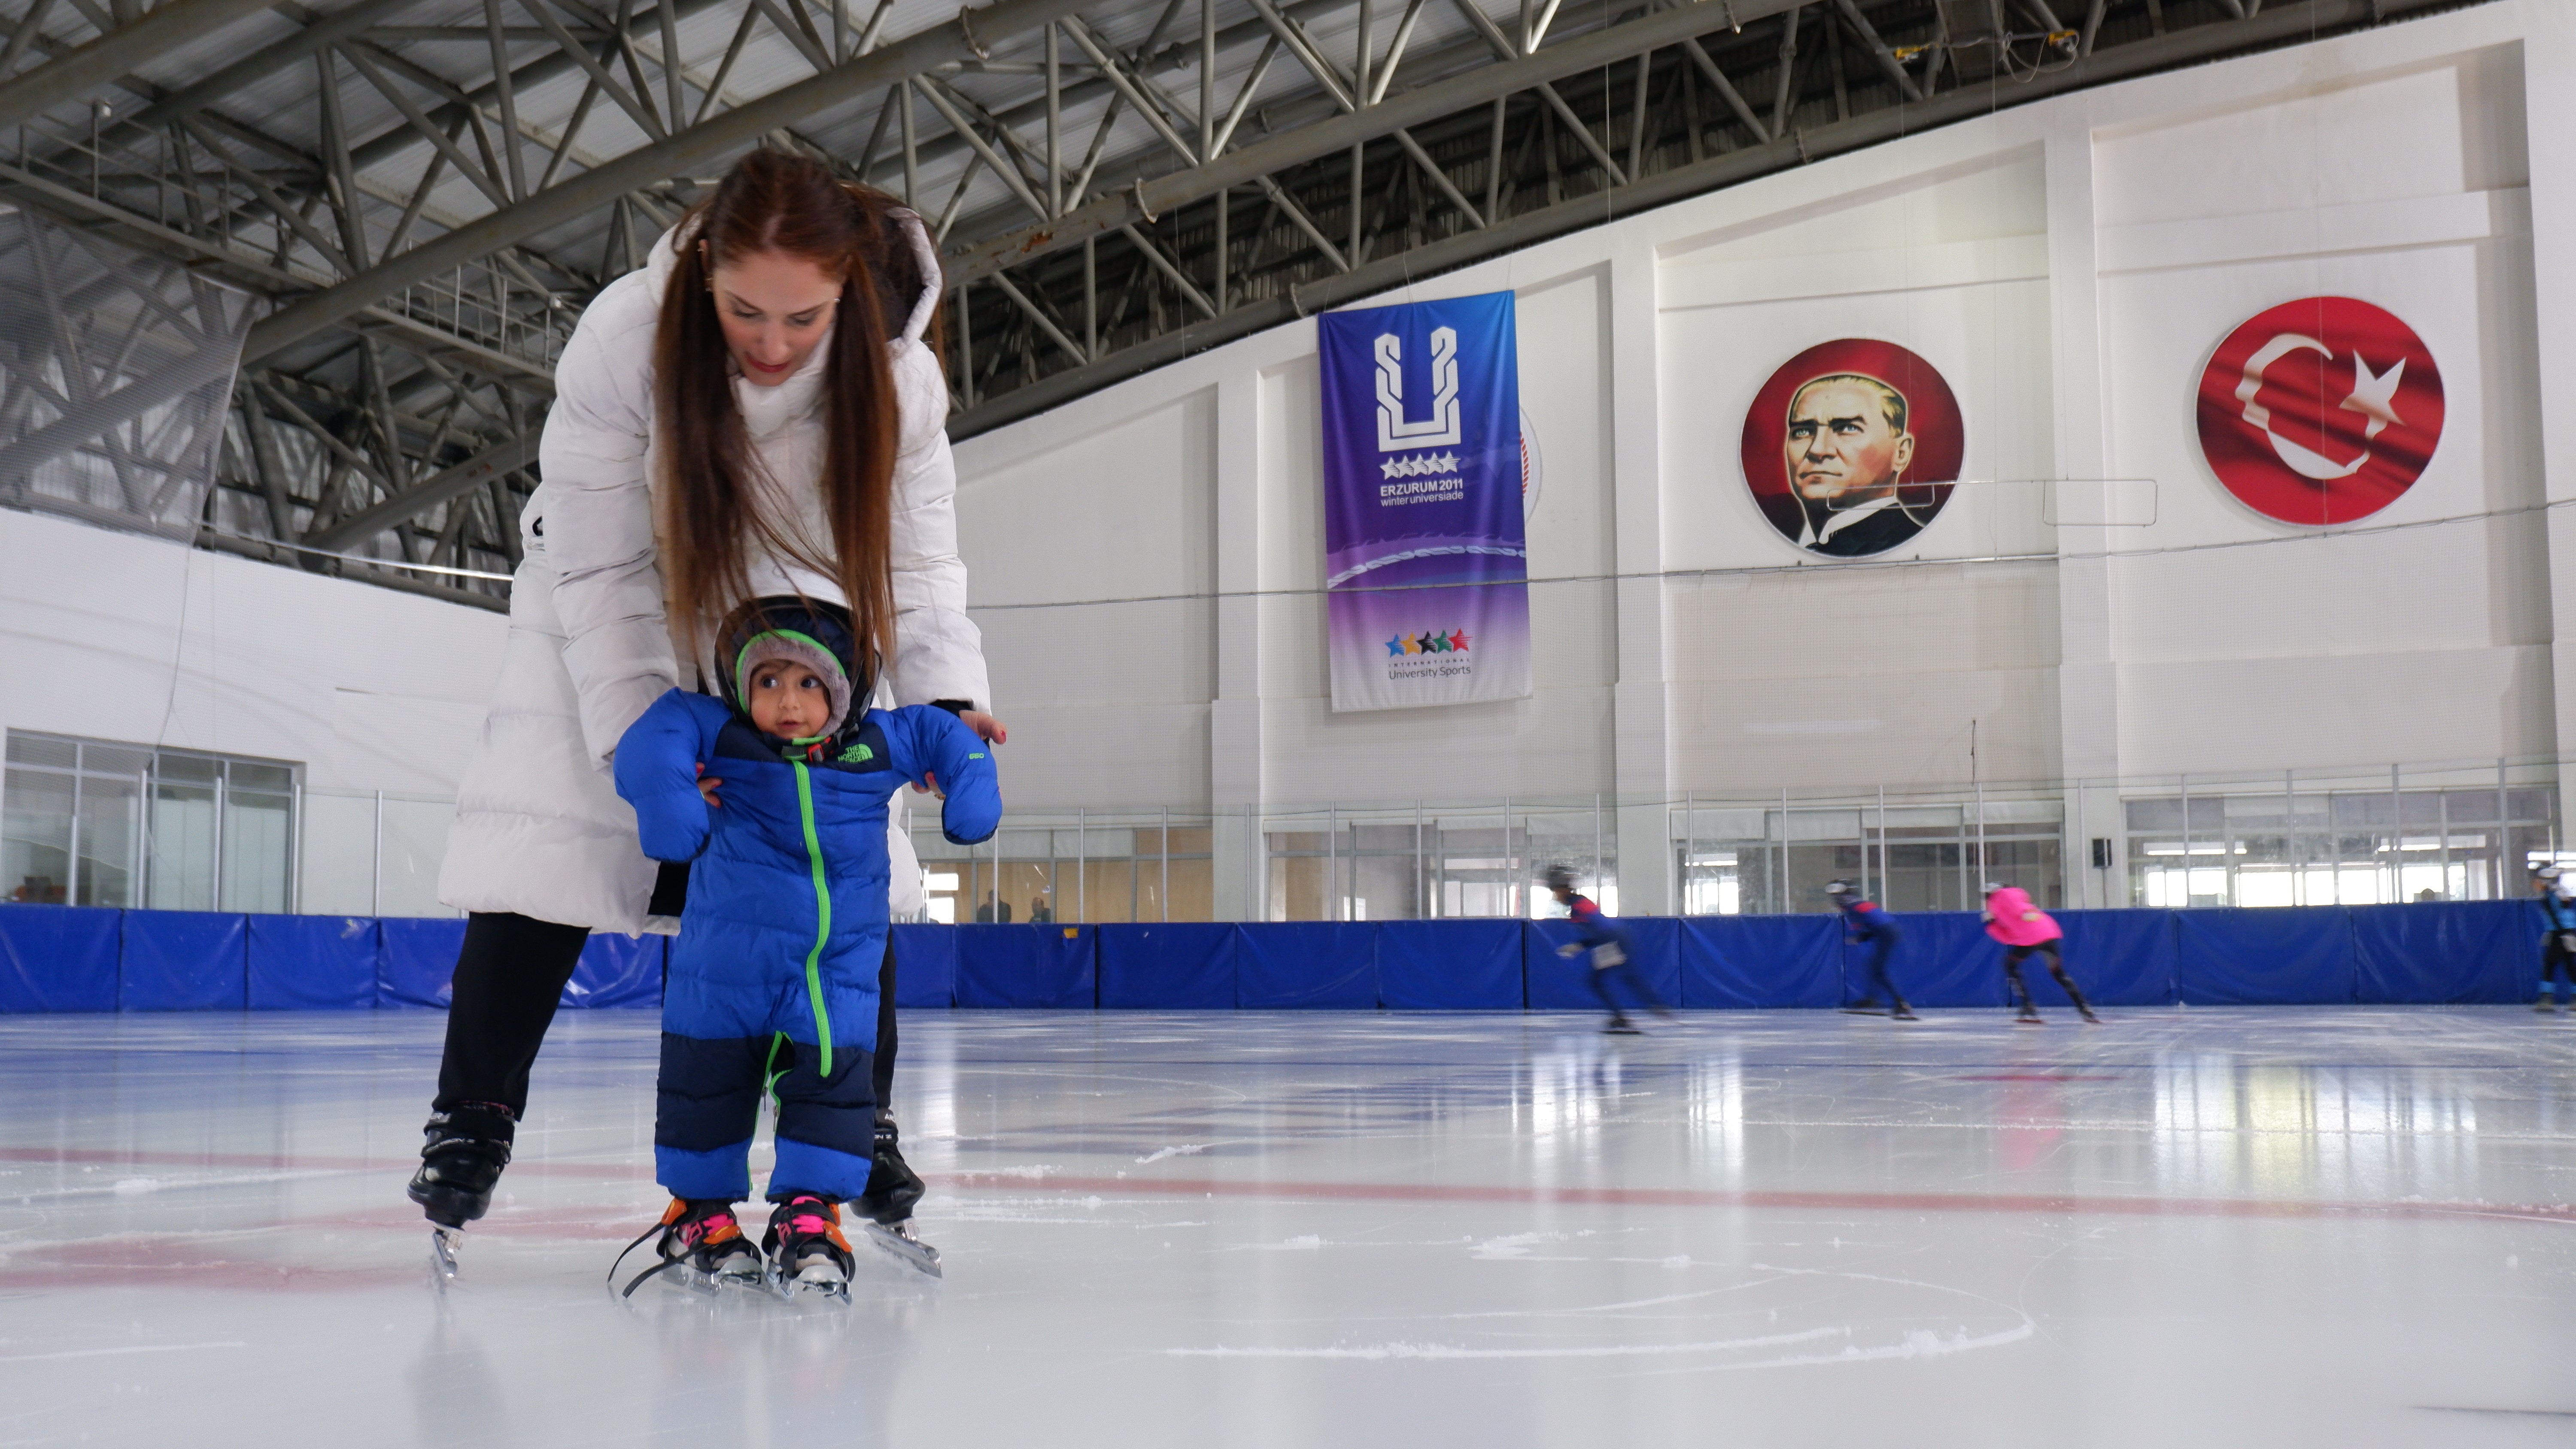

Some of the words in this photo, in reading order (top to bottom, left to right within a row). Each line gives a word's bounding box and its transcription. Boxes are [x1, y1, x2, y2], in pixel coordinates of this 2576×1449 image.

[1380, 481, 1438, 497] ERZURUM
[1439, 478, 1463, 491] 2011
[1381, 497, 1409, 507] winter
[1410, 490, 1464, 504] universiade
[1388, 658, 1470, 667] INTERNATIONAL
[1389, 668, 1438, 679] University
[1440, 666, 1471, 677] Sports
[845, 745, 859, 753] THE
[837, 750, 861, 763] NORTH
